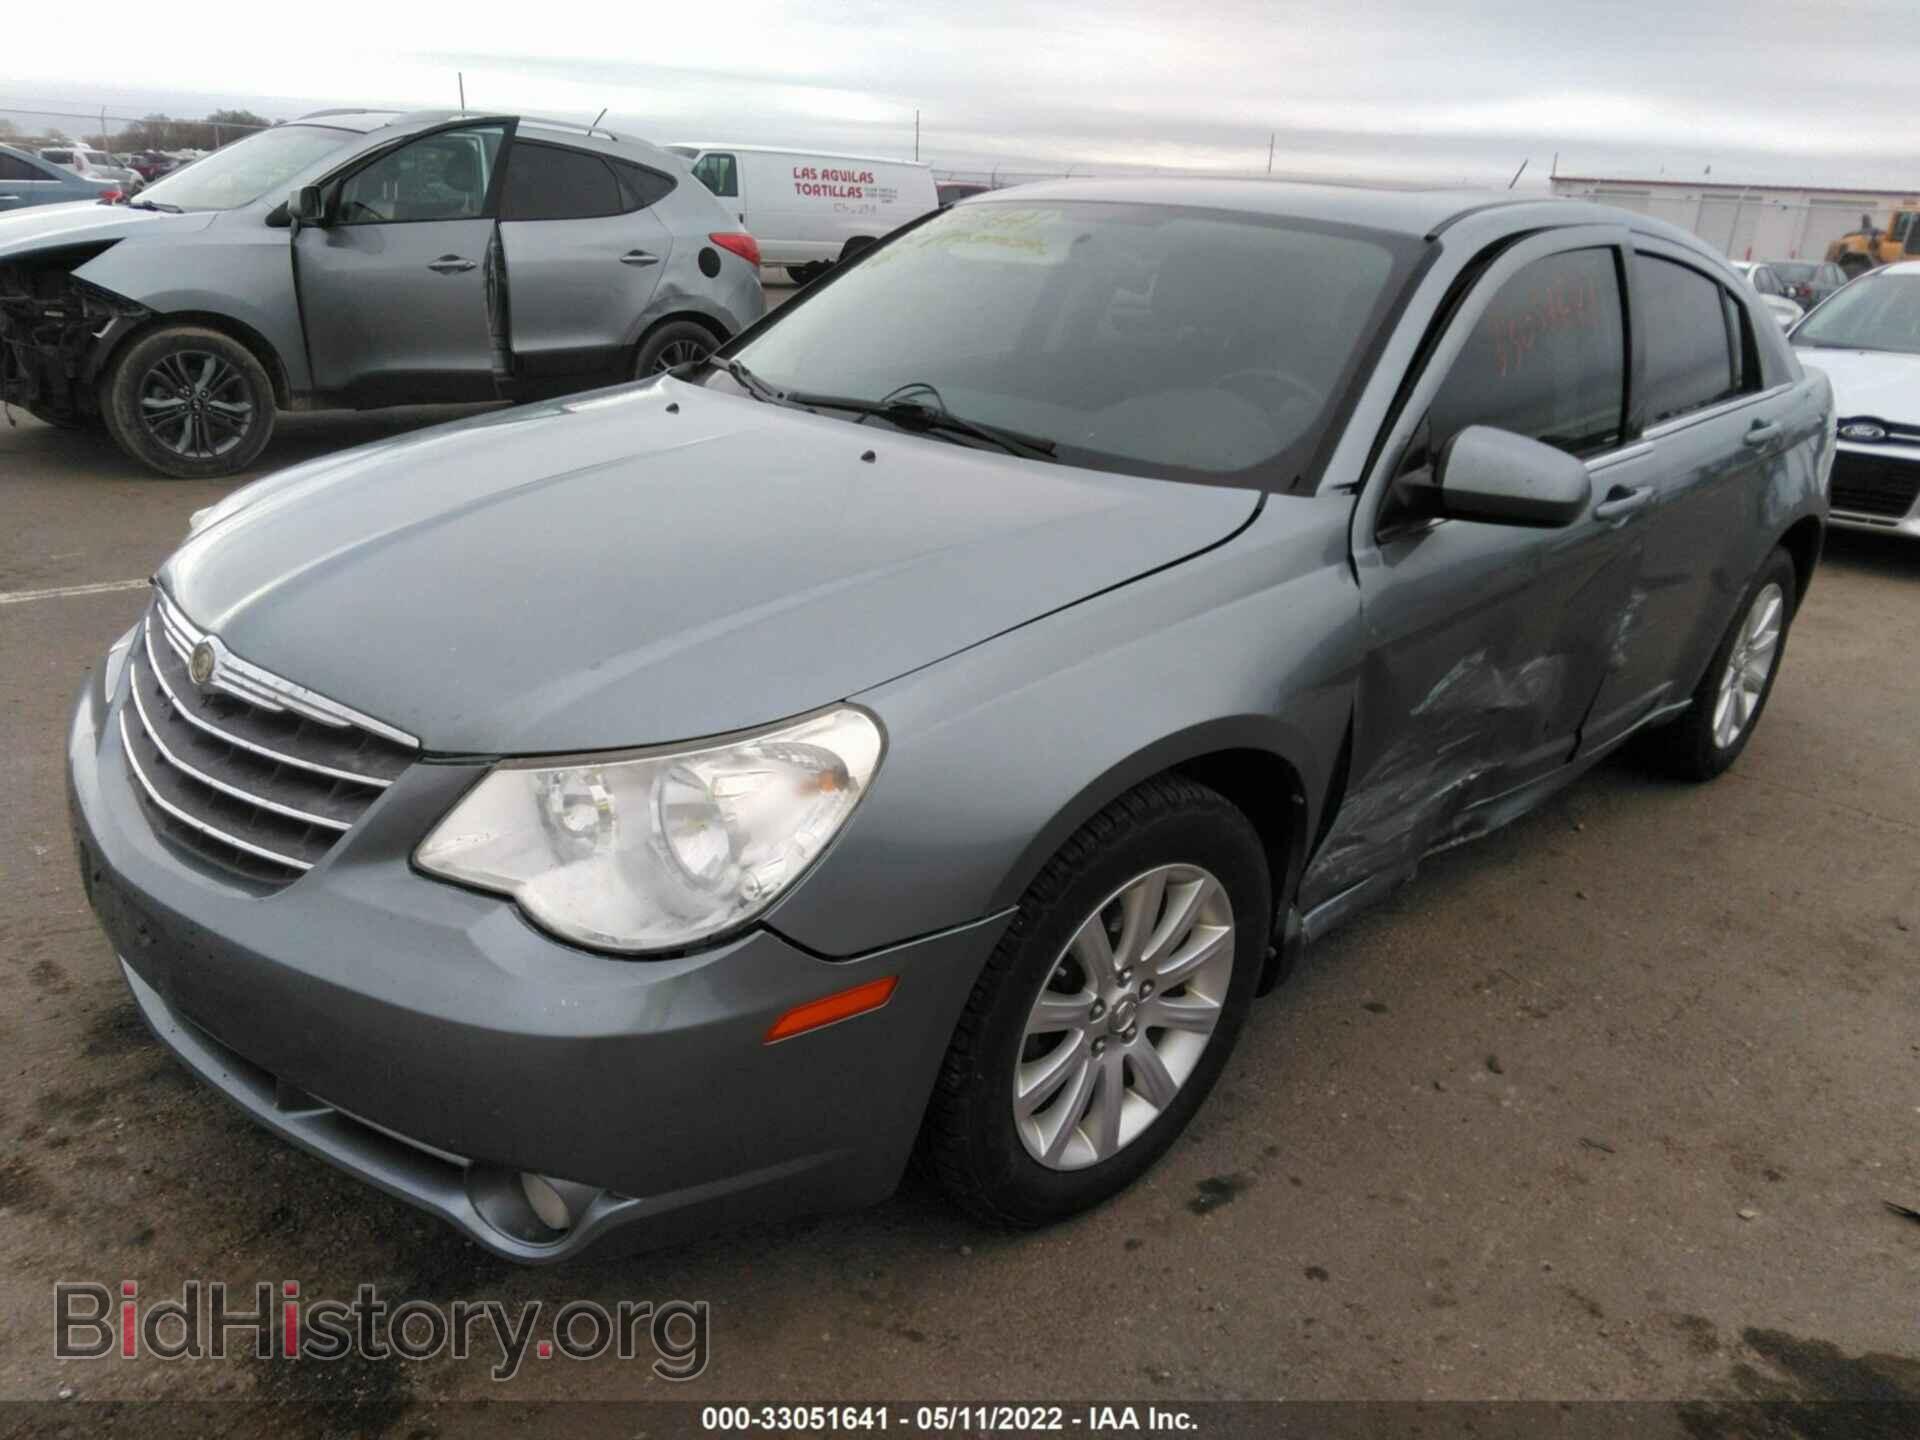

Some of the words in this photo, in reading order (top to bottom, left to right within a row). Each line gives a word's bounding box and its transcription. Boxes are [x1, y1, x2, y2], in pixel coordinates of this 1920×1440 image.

[793, 167, 817, 180] LAS
[821, 169, 875, 184] AGUILAS
[795, 183, 863, 199] TORTILLAS
